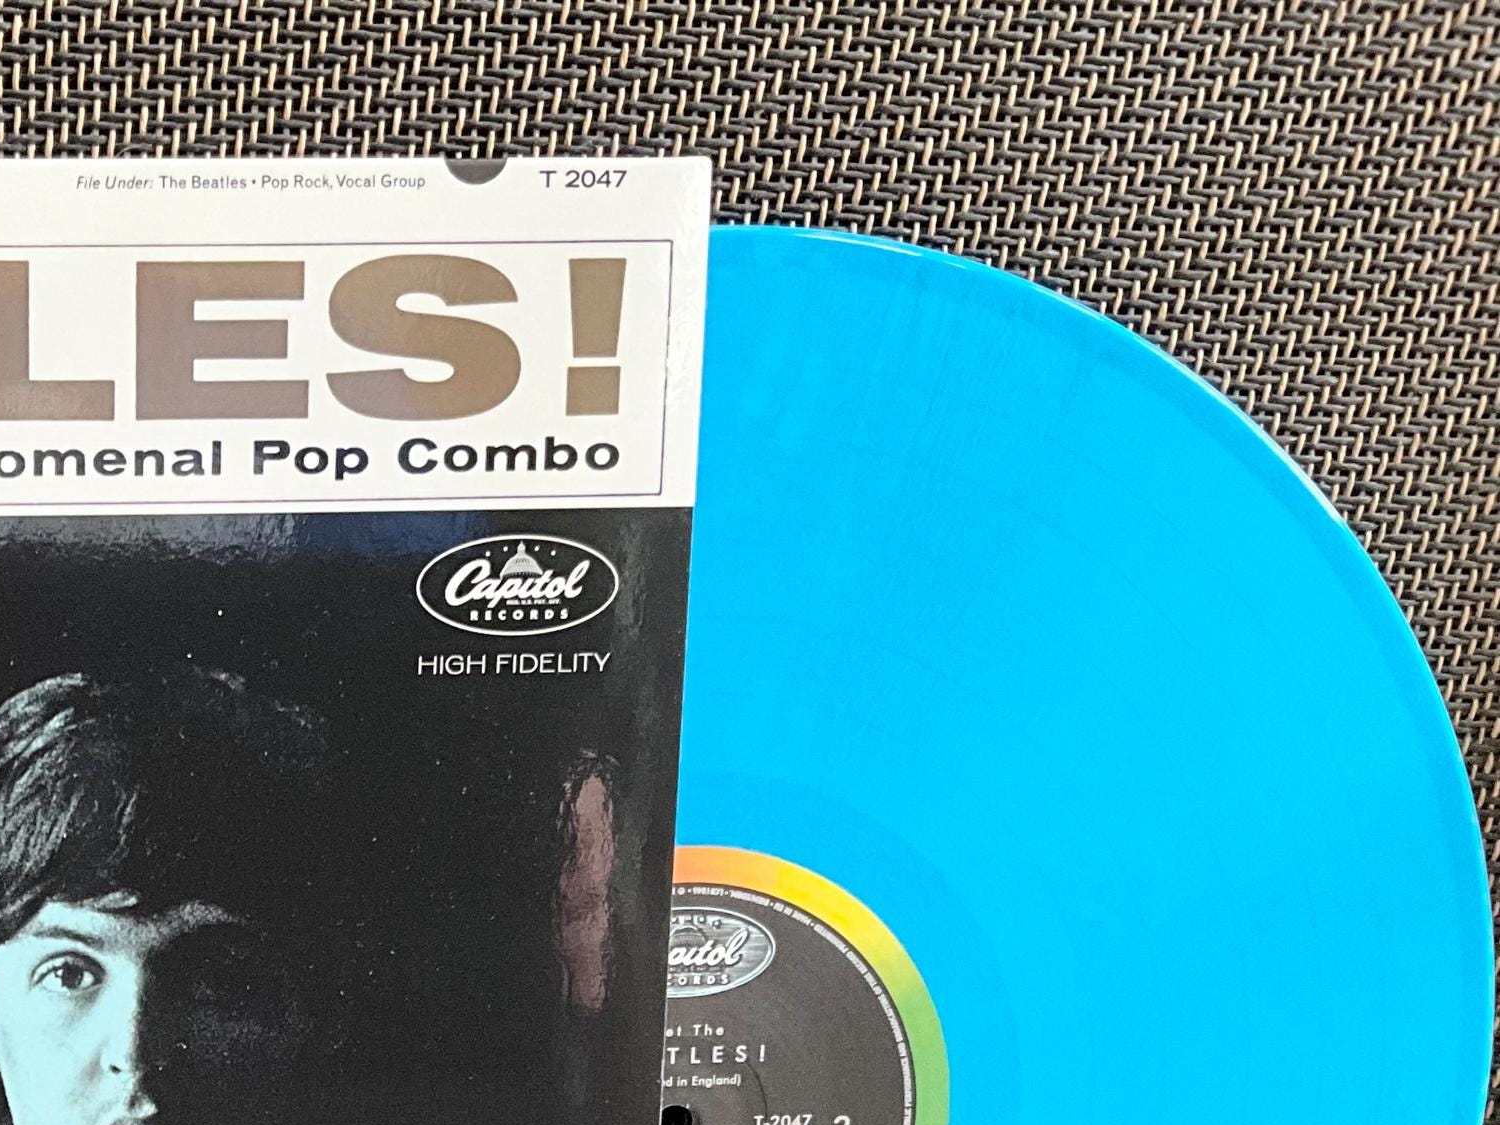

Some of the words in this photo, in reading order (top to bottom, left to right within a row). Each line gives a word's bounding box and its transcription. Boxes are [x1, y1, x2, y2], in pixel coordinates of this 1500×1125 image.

[76, 176, 100, 190] File
[105, 176, 153, 190] Under:
[159, 175, 186, 189] The
[191, 175, 247, 189] Beatles
[261, 175, 289, 191] Pop
[294, 174, 333, 190] Rock,
[336, 174, 376, 189] Vocal
[380, 174, 426, 190] Group
[539, 170, 557, 188] T
[565, 169, 627, 189] 2047
[253, 440, 369, 481] Pop
[397, 436, 622, 473] Combo
[445, 558, 590, 609] Capitol
[470, 608, 569, 621] RECORDS
[417, 654, 487, 675] HIGH
[495, 652, 611, 674] FIDELITY
[665, 1025, 682, 1038] et
[692, 1023, 725, 1037] The
[666, 1044, 766, 1065] TLES!
[677, 1075, 687, 1087] in
[691, 1074, 741, 1088] England)
